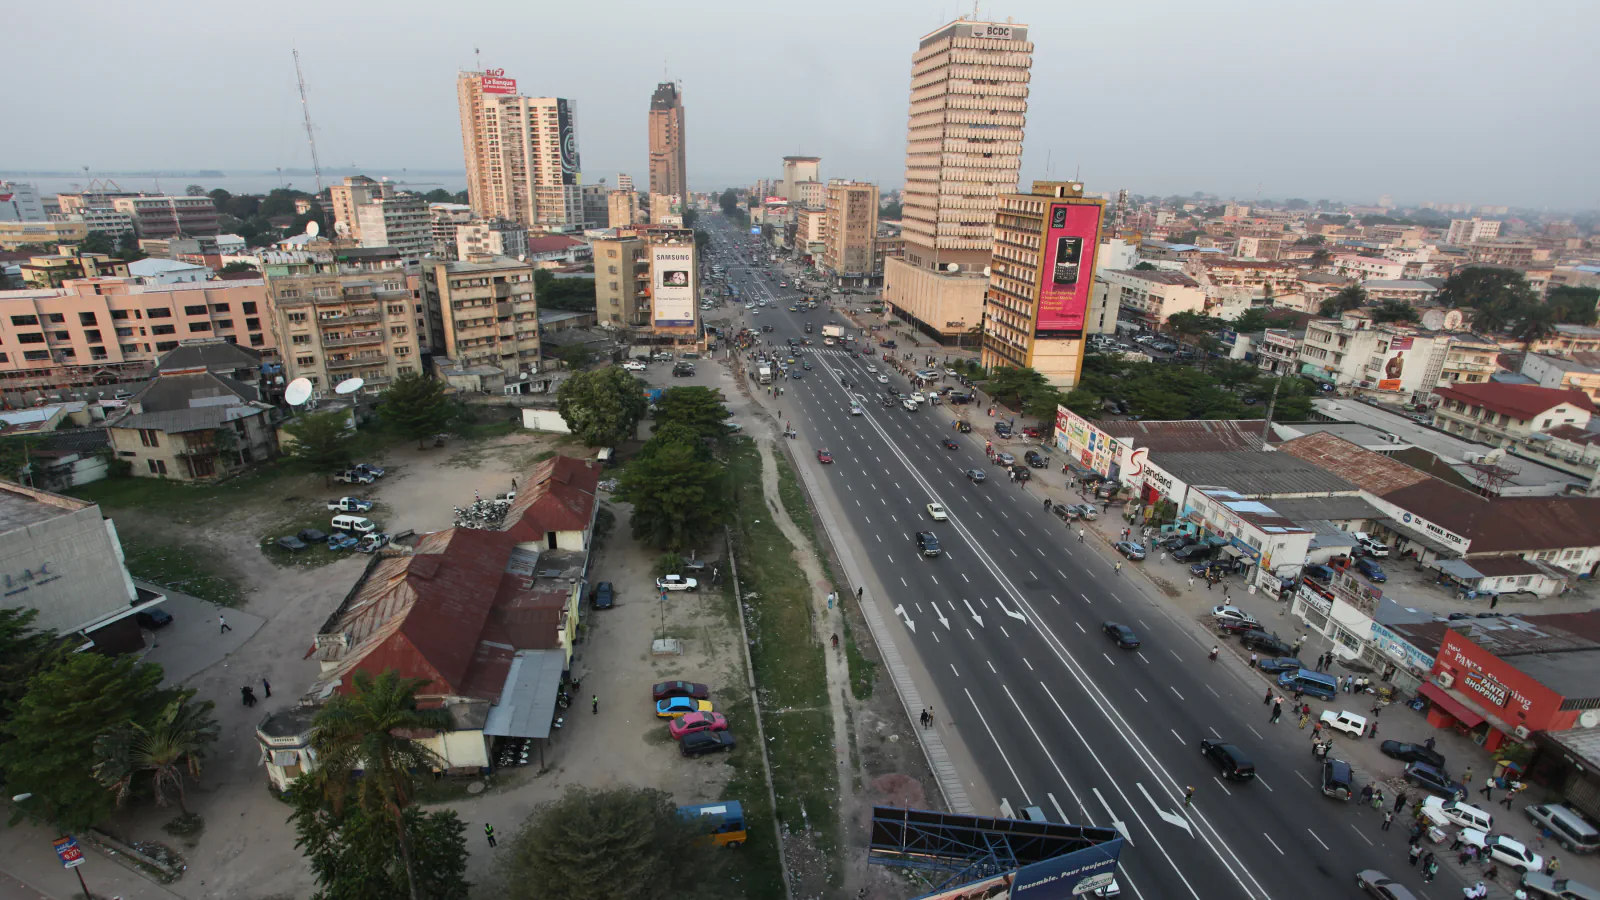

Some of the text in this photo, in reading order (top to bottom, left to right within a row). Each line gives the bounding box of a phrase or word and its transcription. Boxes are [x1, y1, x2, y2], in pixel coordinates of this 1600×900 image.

[987, 26, 1010, 36] BCDC
[1128, 450, 1172, 489] Standard
[1371, 622, 1393, 638] BABY
[1402, 642, 1435, 668] CENTER
[1464, 677, 1502, 706] SHOPPING
[1480, 678, 1505, 698] PANTA
[1018, 858, 1116, 891] Ensemble. Pour toujours.
[1078, 876, 1112, 890] vodacom
